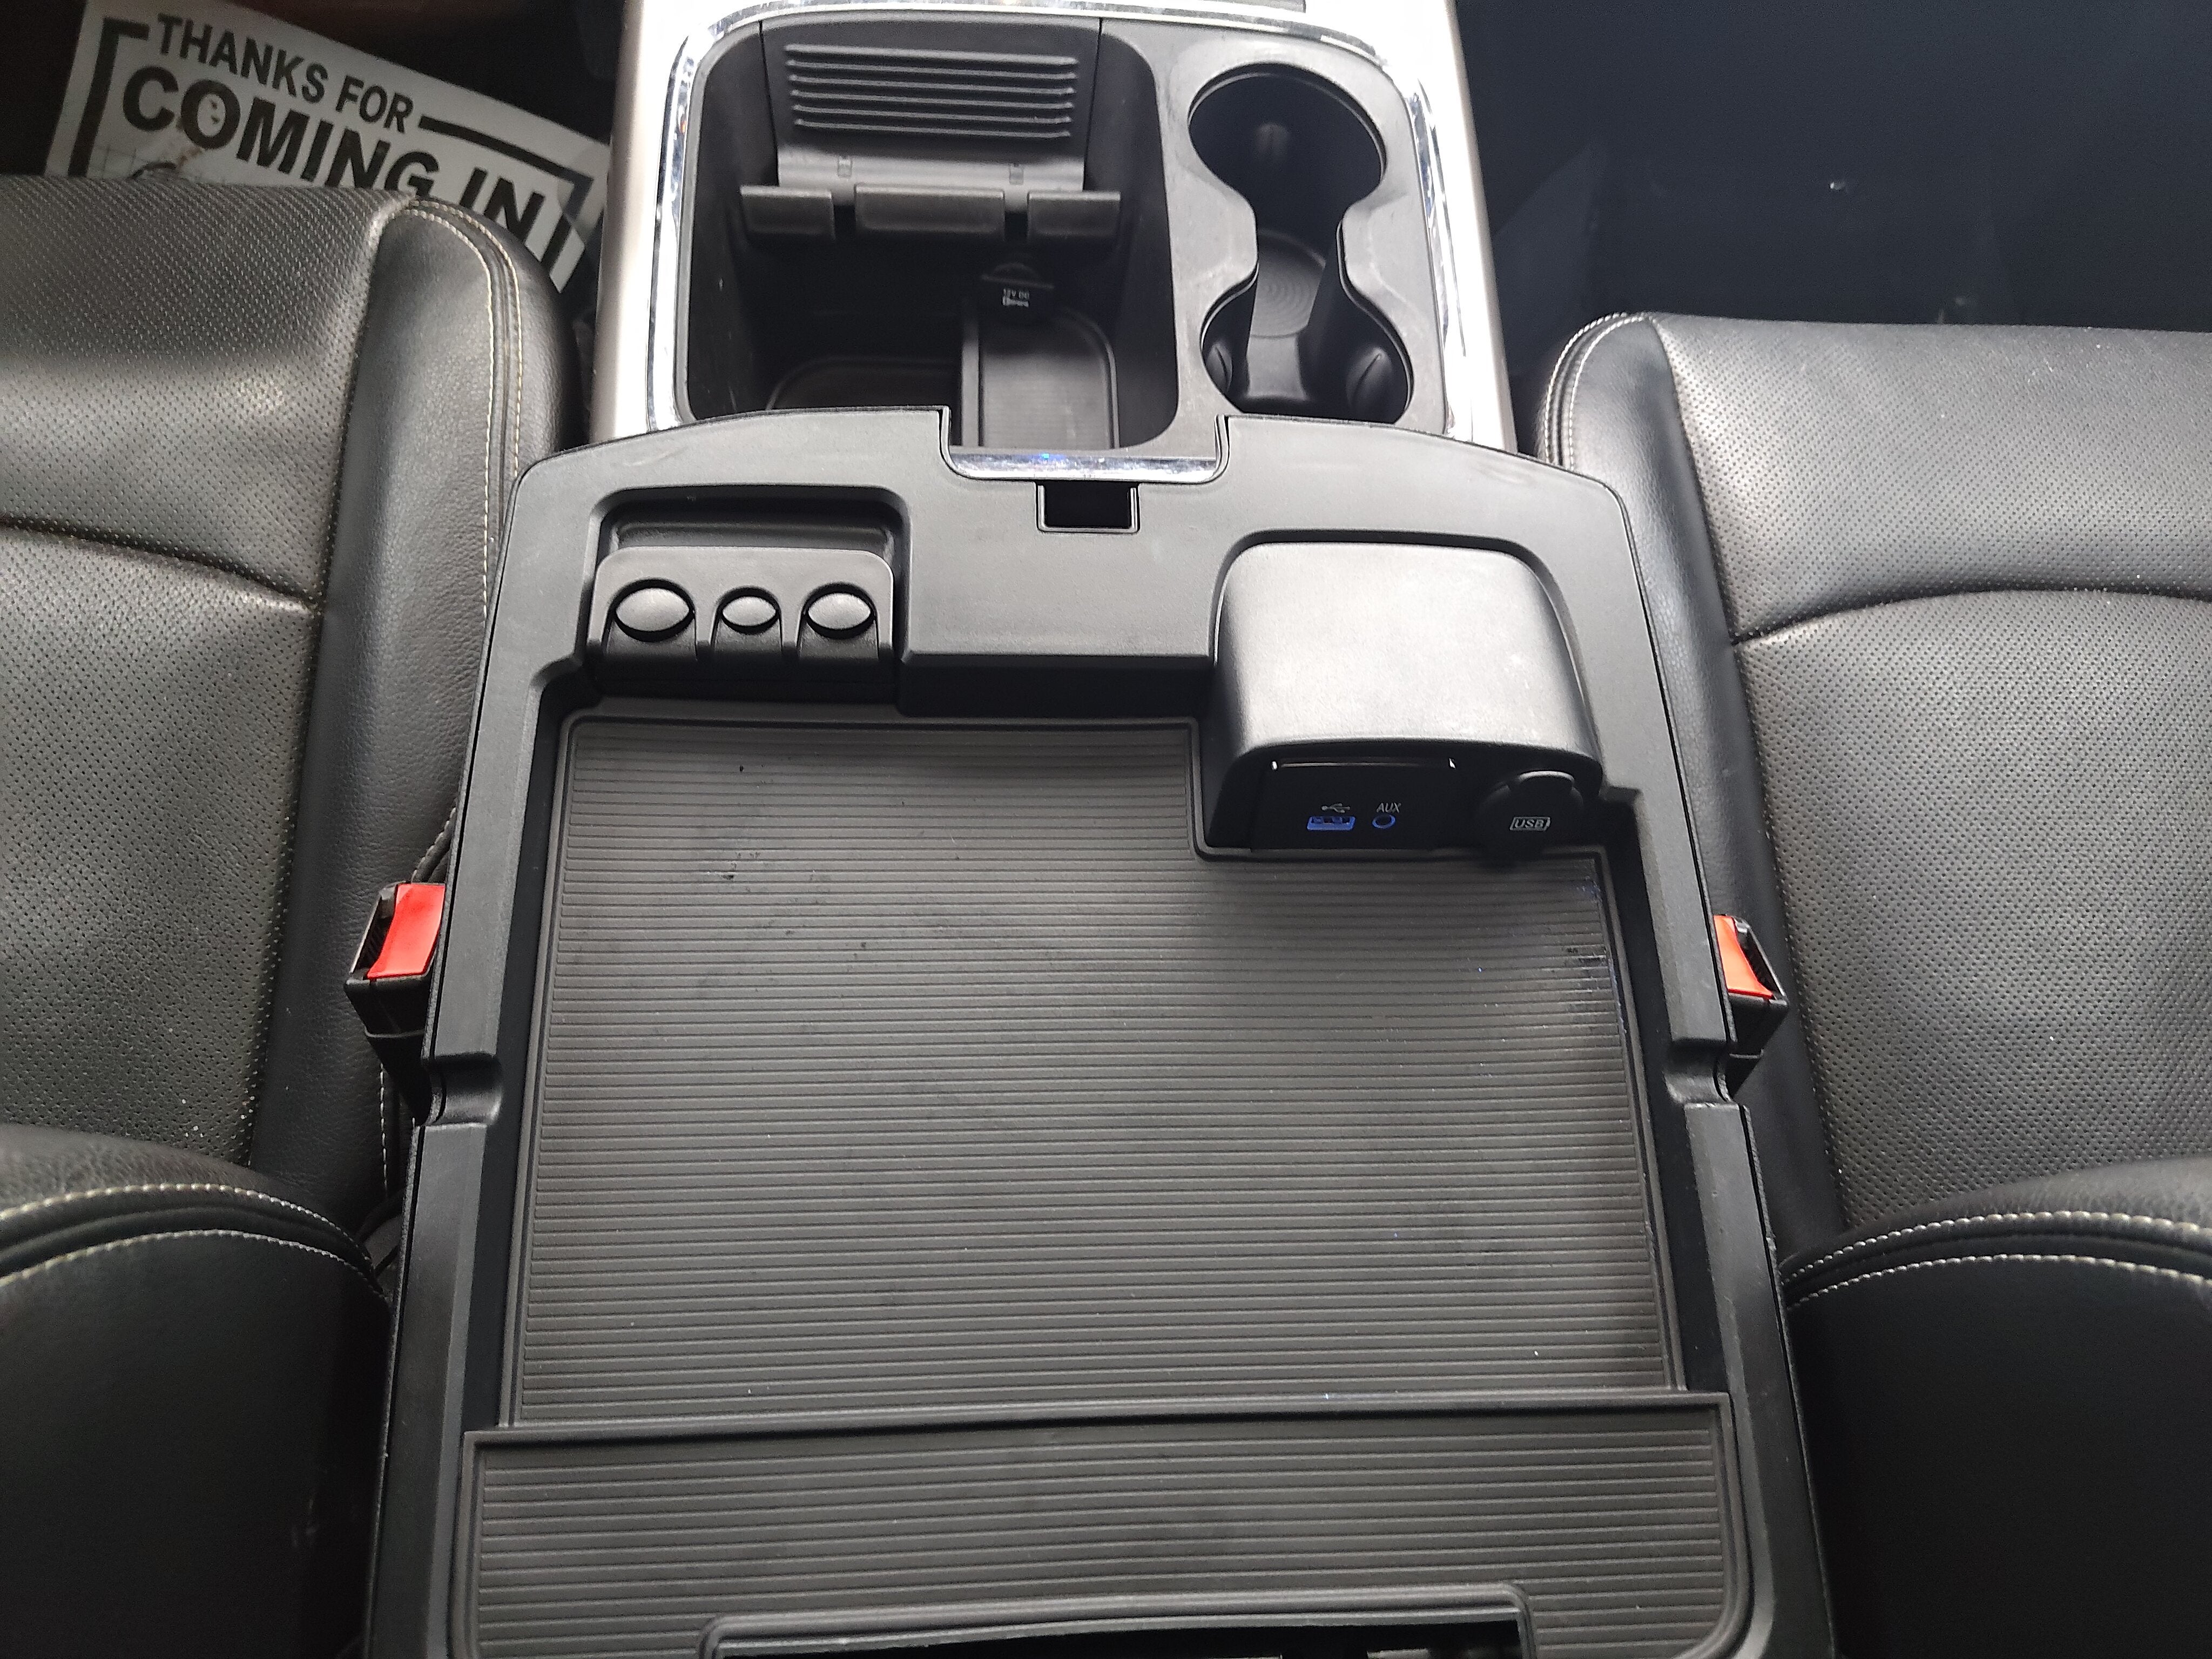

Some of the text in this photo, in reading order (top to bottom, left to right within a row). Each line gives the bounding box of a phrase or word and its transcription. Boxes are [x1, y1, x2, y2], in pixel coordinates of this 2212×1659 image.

[158, 12, 414, 134] THANKS FOR
[123, 65, 545, 243] COMING IN
[1376, 802, 1402, 813] AUX
[1514, 819, 1545, 830] USB
